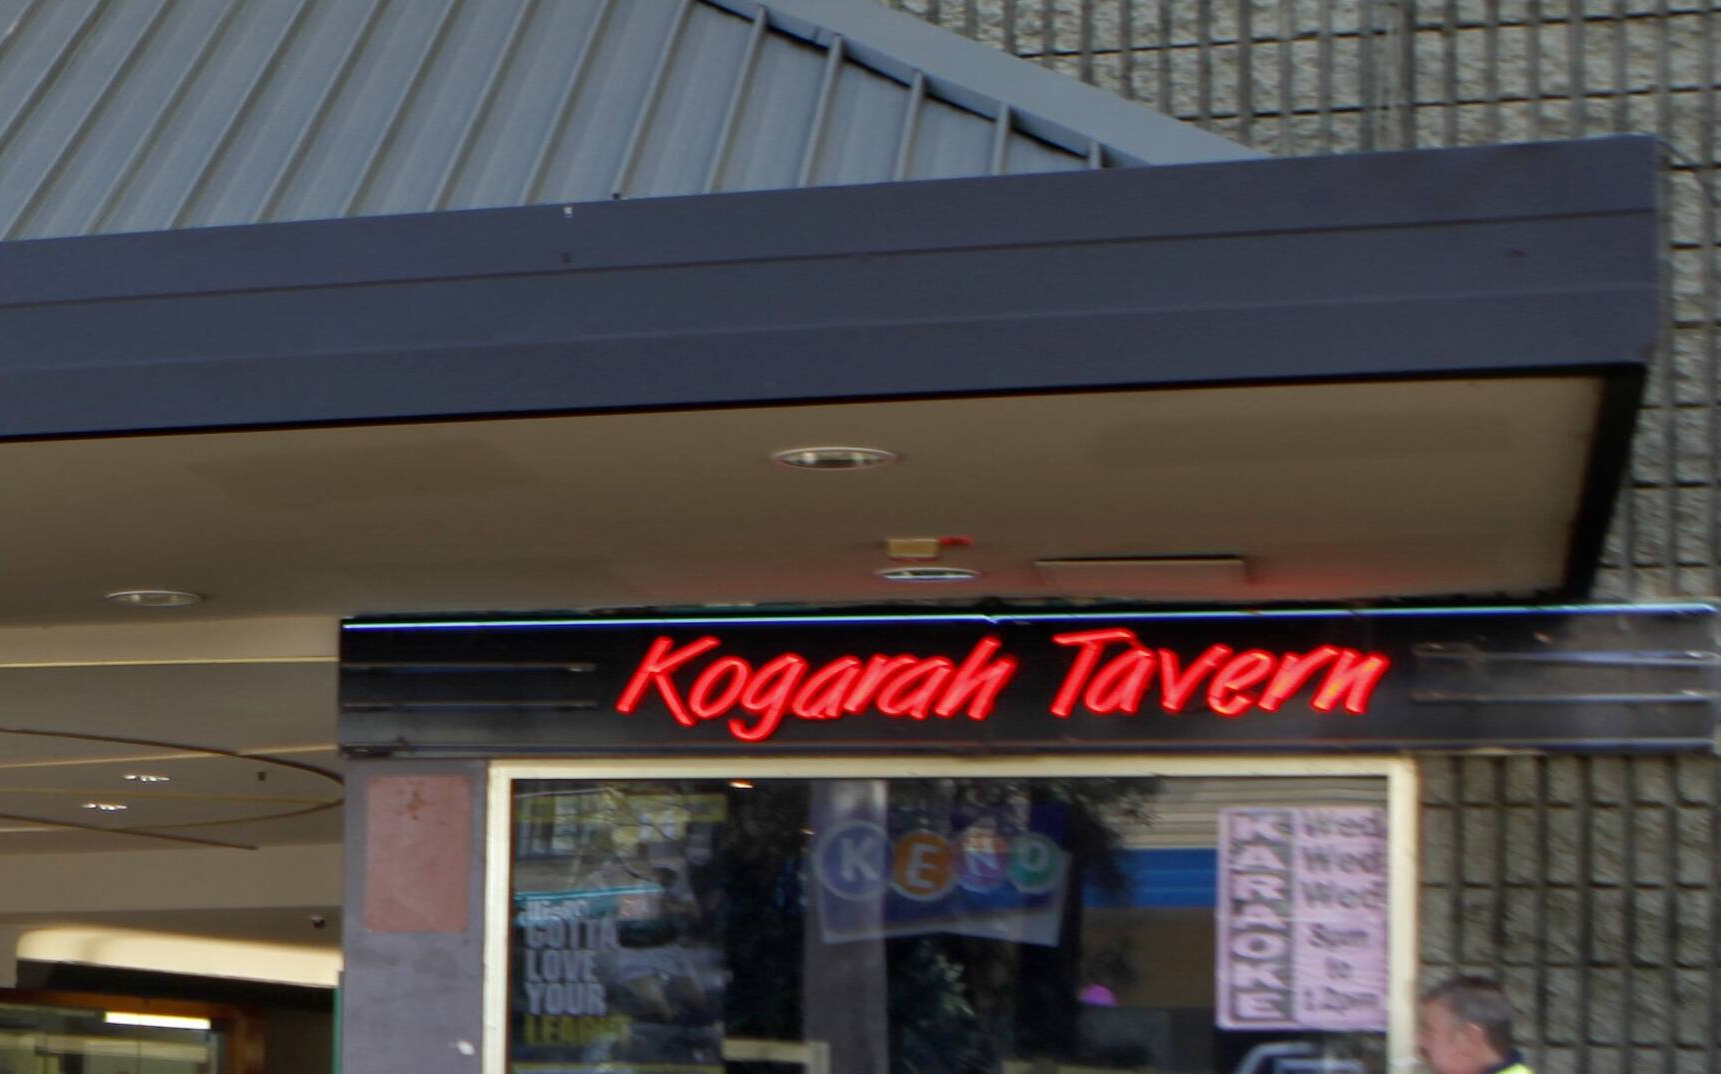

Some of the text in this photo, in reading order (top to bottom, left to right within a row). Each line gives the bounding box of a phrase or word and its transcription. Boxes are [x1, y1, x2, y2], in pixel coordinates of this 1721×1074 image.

[615, 628, 1390, 743] Kogarah Tavern
[834, 832, 1055, 892] KENO
[1231, 812, 1291, 1020] KARAOKE
[526, 949, 597, 982] LOVE
[525, 982, 607, 1015] YOUR
